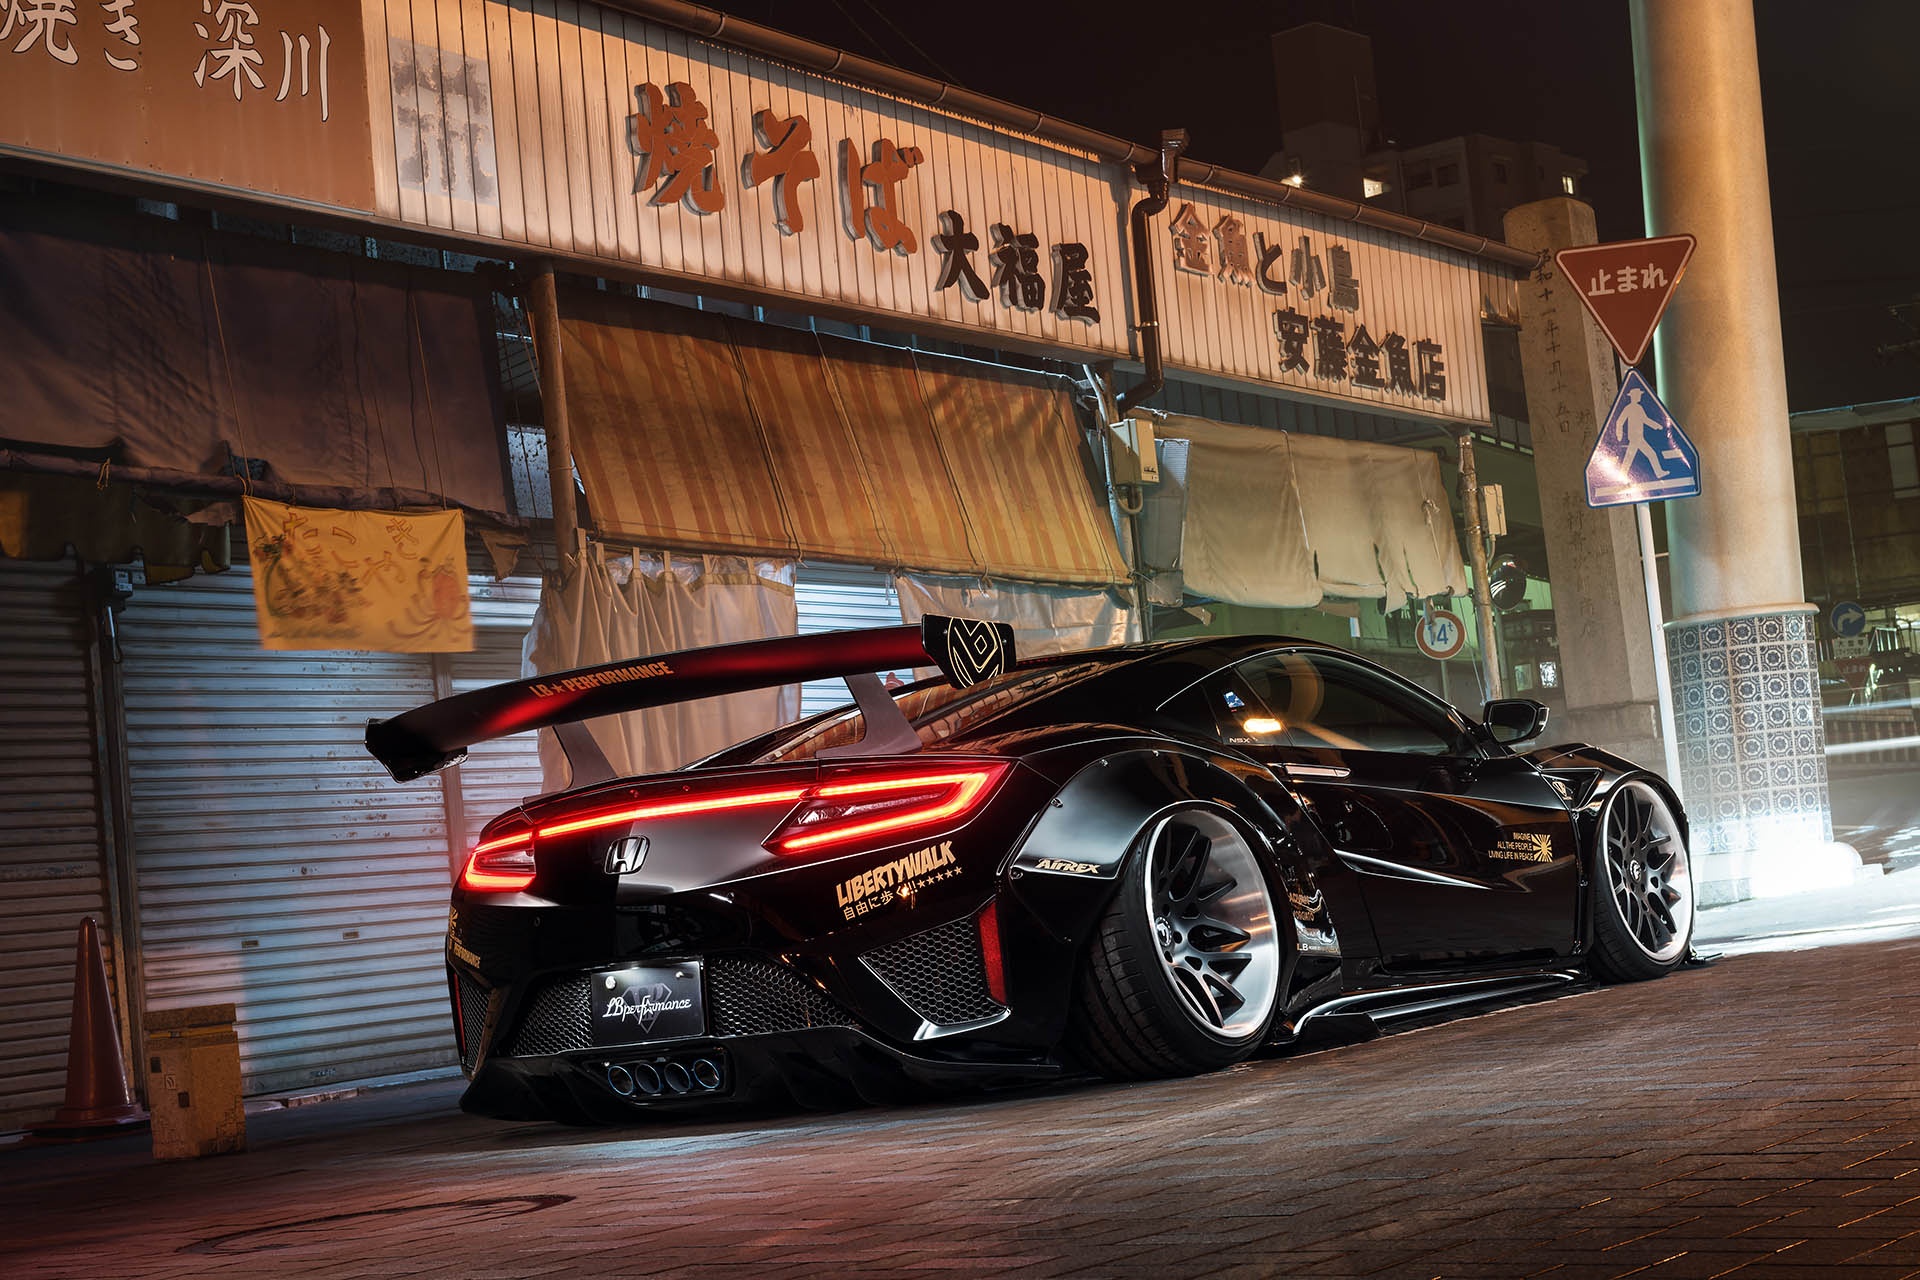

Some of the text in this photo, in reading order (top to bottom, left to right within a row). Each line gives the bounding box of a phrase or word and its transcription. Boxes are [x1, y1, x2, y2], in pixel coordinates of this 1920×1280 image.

[626, 81, 925, 258] 焼そば
[931, 209, 1101, 327] 大福屋
[1588, 263, 1668, 296] 止まれ
[529, 661, 674, 698] LB PERFORMANCE
